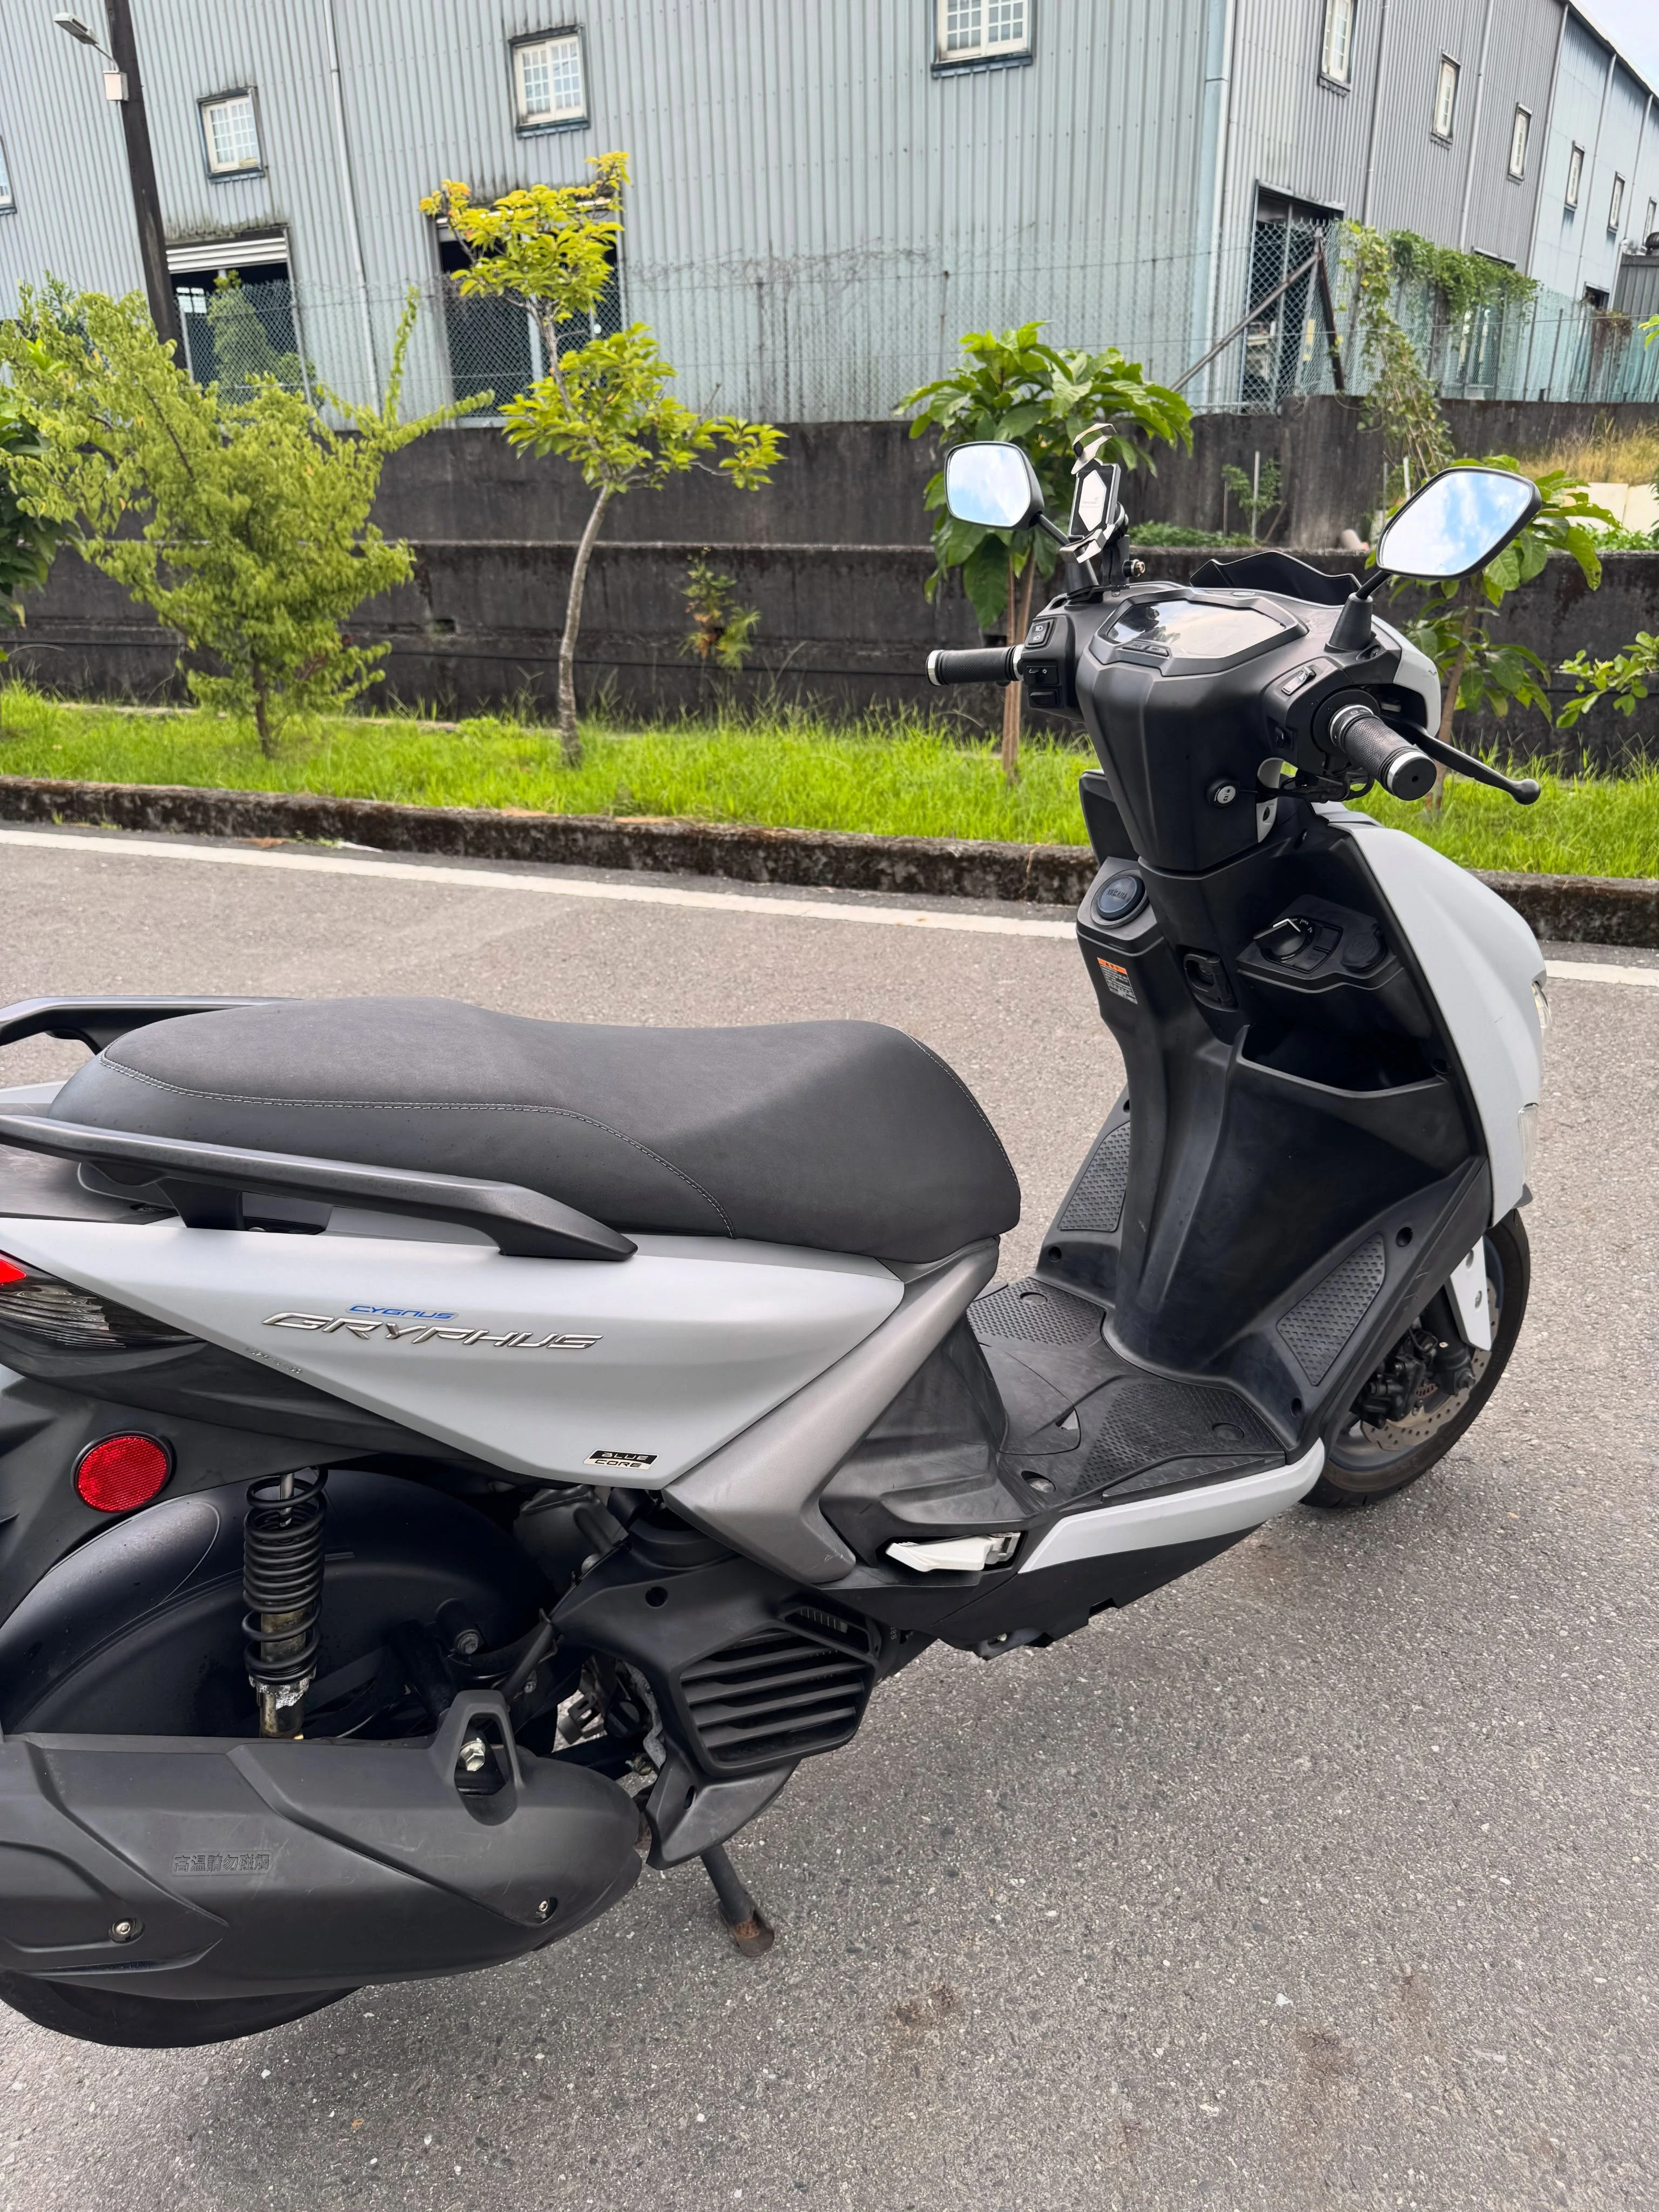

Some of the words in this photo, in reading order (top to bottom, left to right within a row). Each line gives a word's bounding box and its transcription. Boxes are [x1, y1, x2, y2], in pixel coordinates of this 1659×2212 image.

[349, 1305, 455, 1319] CYGNUS
[262, 1312, 604, 1349] GRYPHUS
[601, 1452, 649, 1461] BLUE
[595, 1459, 642, 1468] CORE
